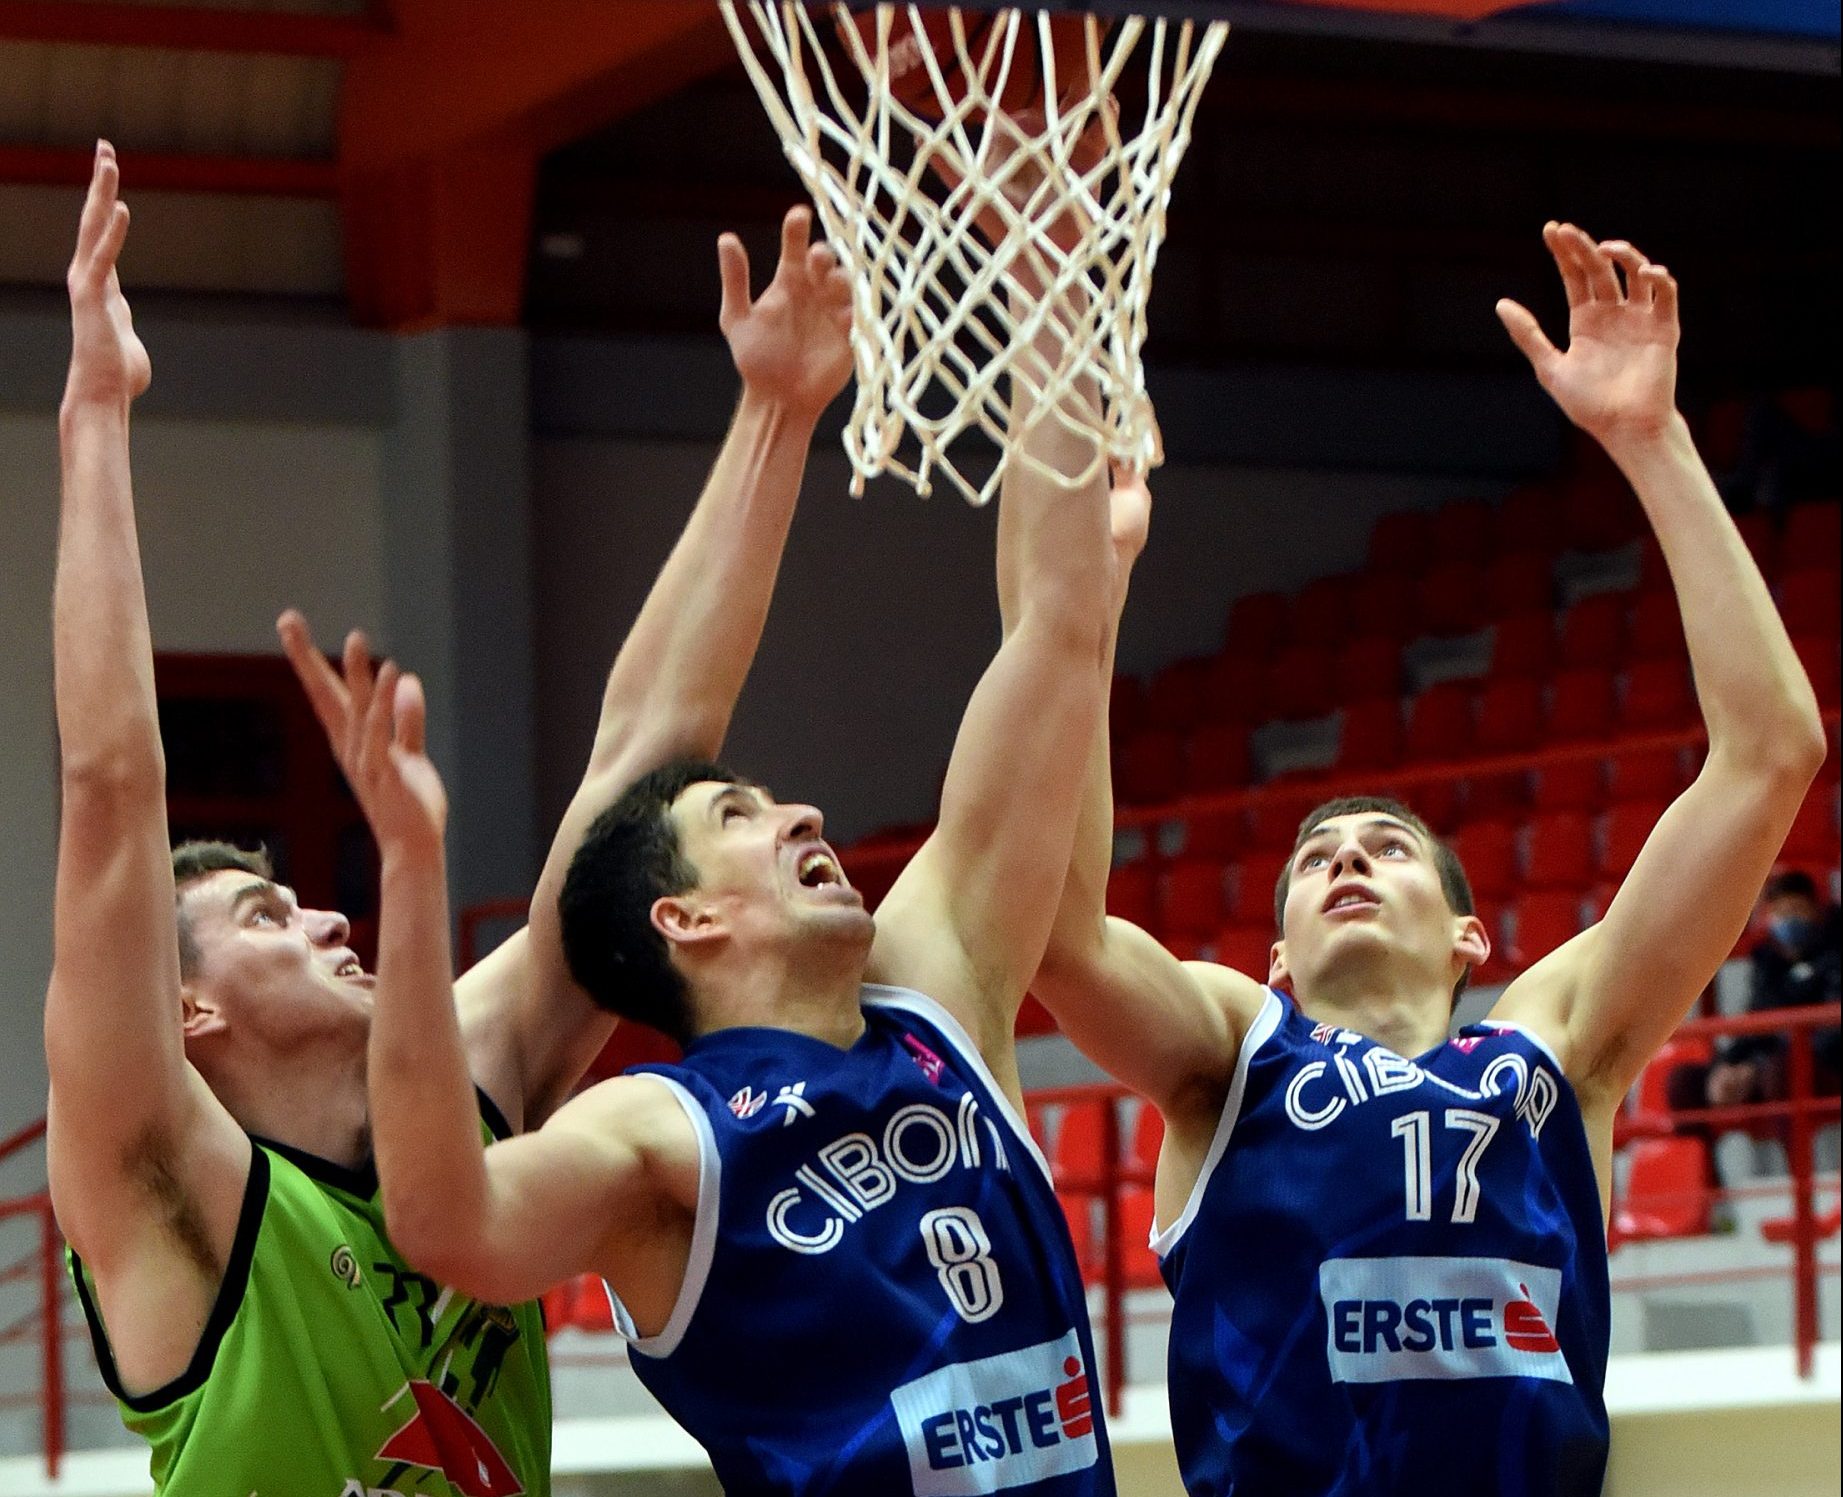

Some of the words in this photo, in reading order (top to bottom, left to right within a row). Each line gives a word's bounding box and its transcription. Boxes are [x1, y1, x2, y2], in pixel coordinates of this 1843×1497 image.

[1391, 1108, 1500, 1223] 17
[920, 1206, 1004, 1324] 8
[1333, 1297, 1497, 1354] ERSTE
[921, 1387, 1061, 1471] ERSTE
